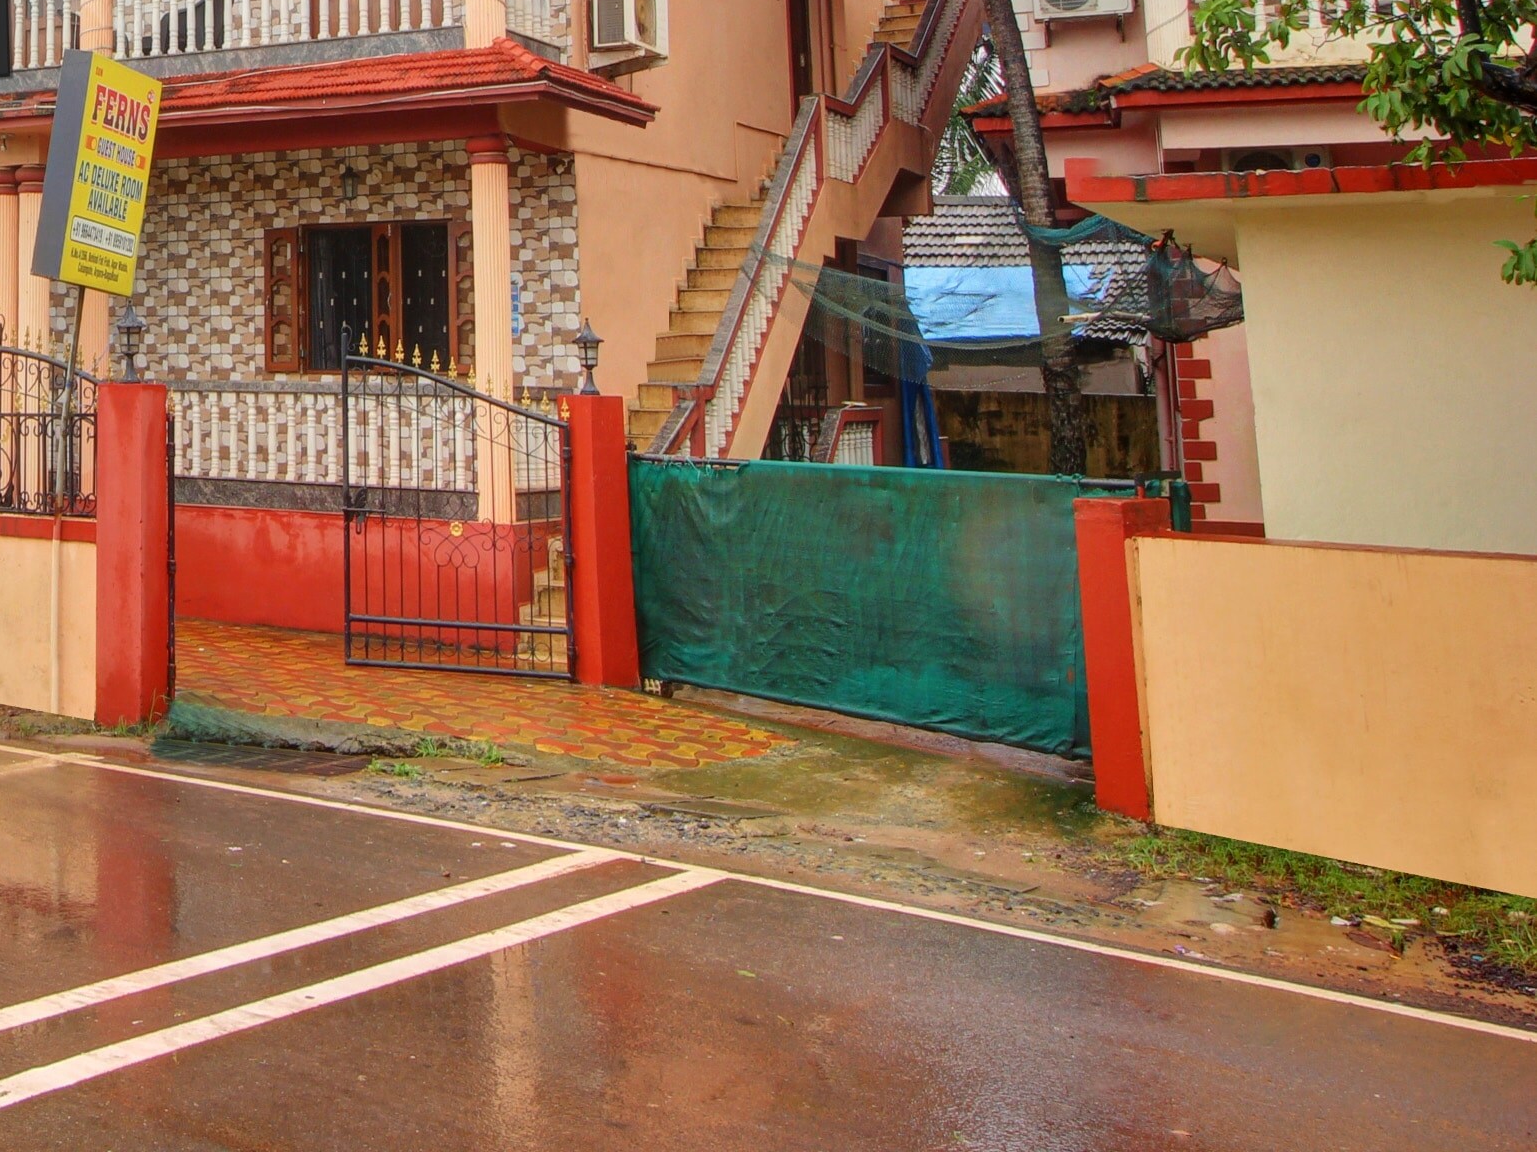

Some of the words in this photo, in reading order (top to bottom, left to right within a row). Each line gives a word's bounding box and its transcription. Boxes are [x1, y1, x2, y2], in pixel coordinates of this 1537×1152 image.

[91, 84, 151, 144] FERNS
[96, 136, 116, 159] GUEST
[116, 142, 136, 167] HOUSE
[77, 160, 90, 183] AC
[90, 164, 120, 194] DELUXE
[120, 172, 143, 202] ROOM
[87, 188, 128, 222] AVAILABLE
